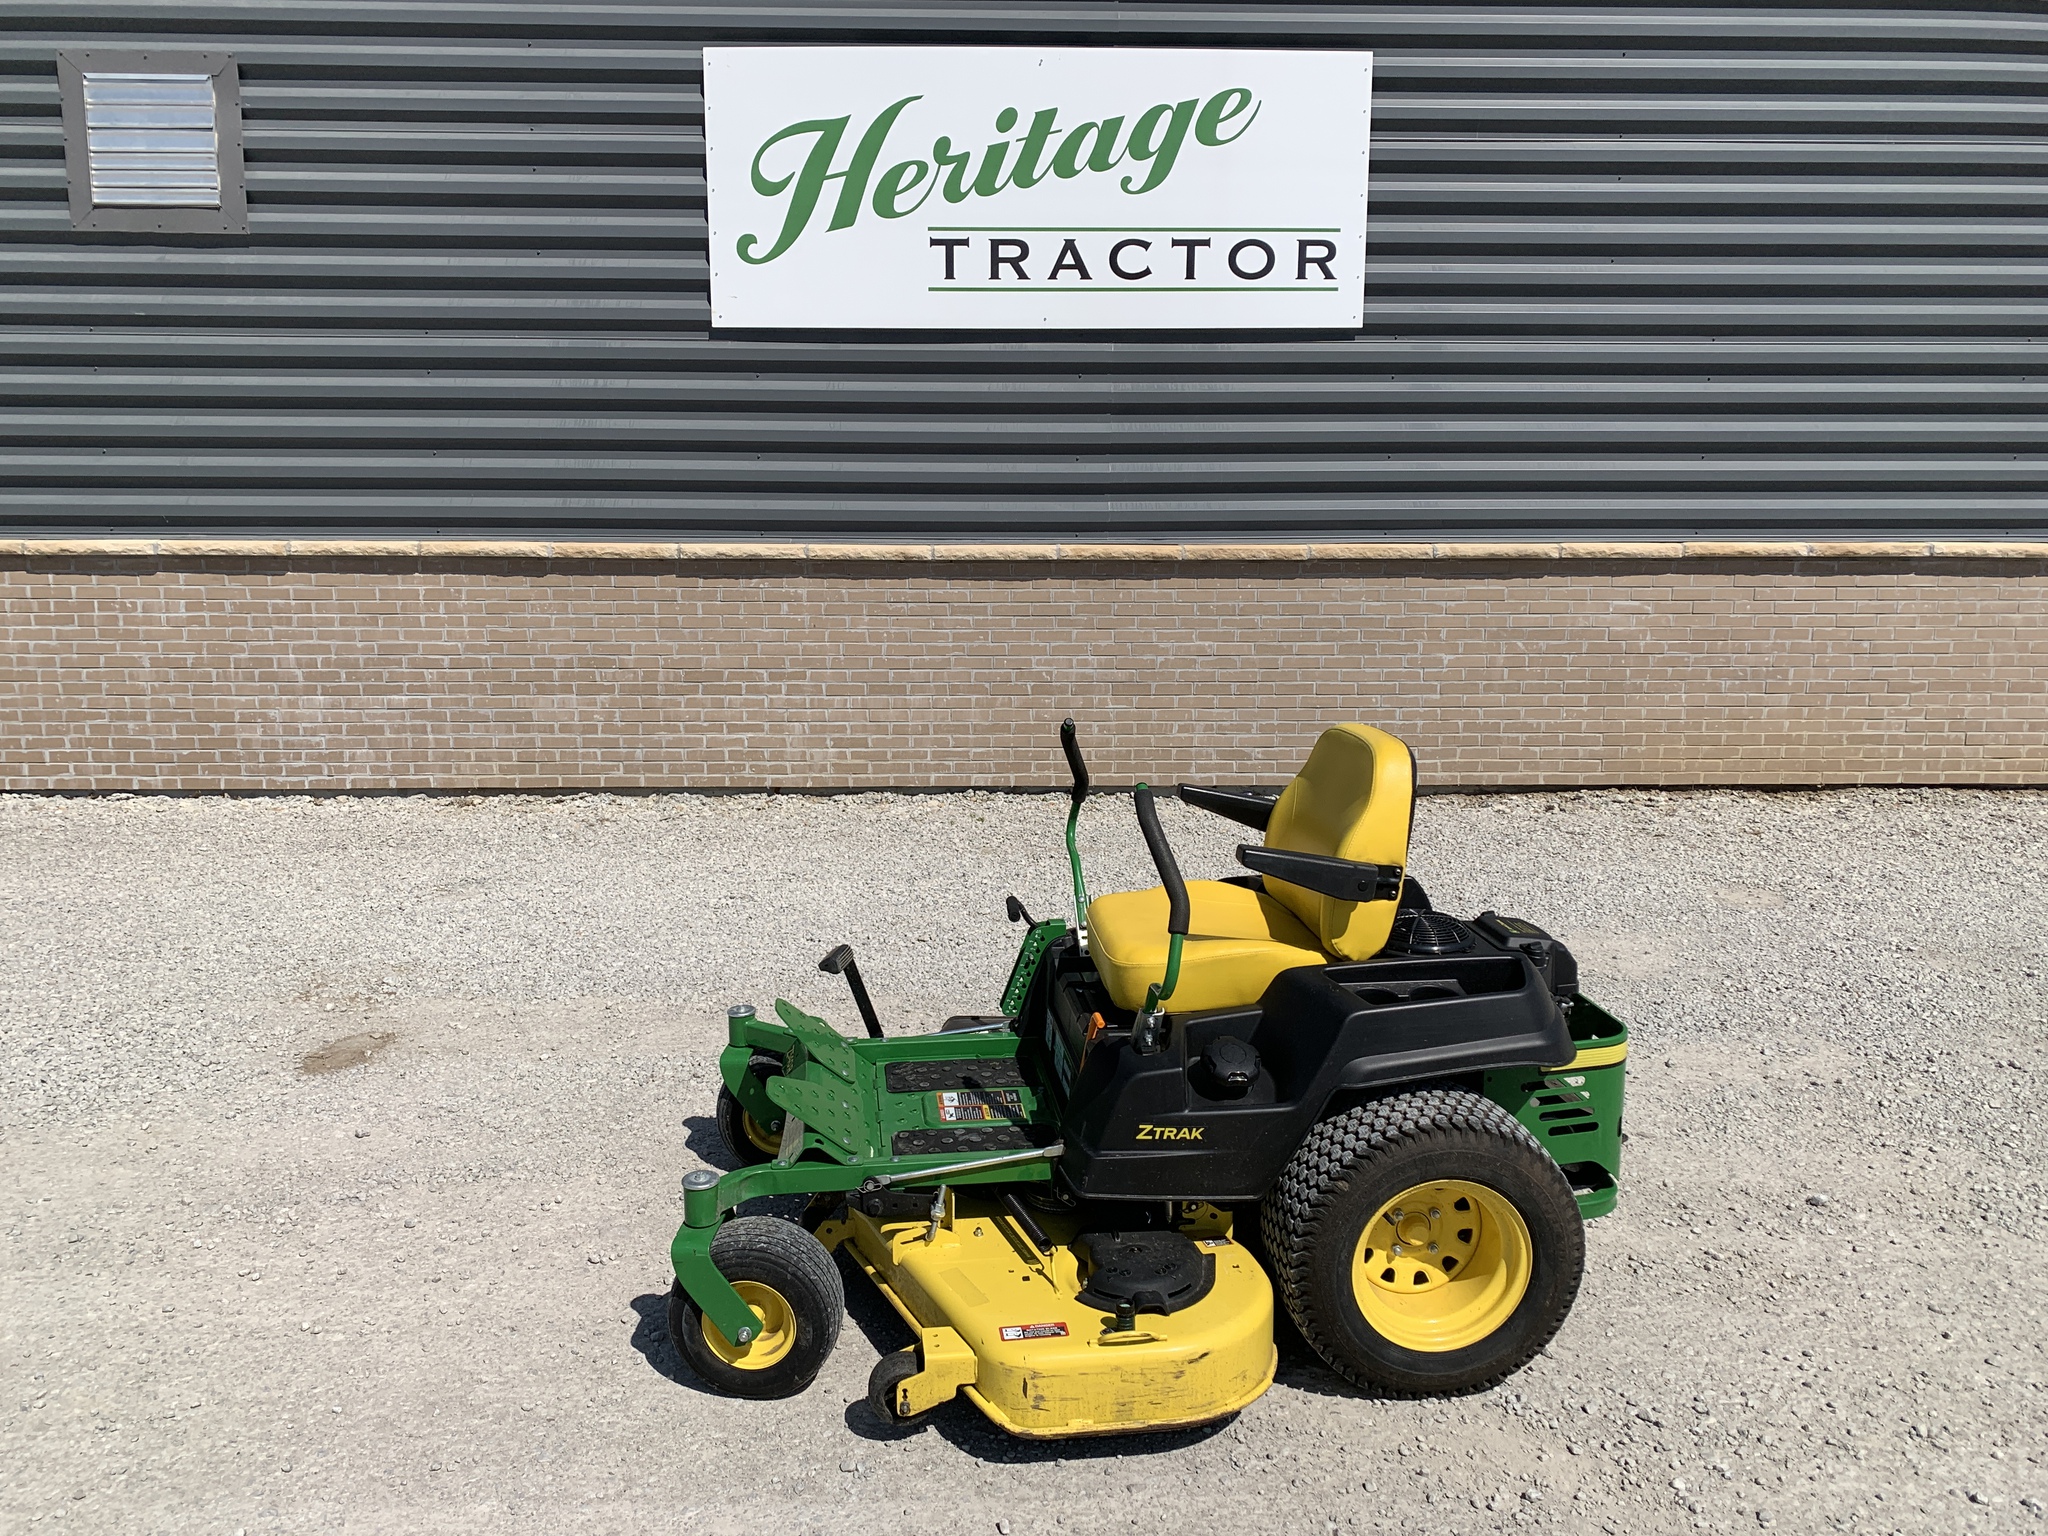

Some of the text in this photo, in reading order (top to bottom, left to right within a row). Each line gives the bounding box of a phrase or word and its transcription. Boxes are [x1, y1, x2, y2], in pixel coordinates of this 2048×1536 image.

[736, 88, 1262, 264] Heritage
[929, 236, 1339, 281] TRACTOR
[1136, 1124, 1206, 1141] ZTRAK
